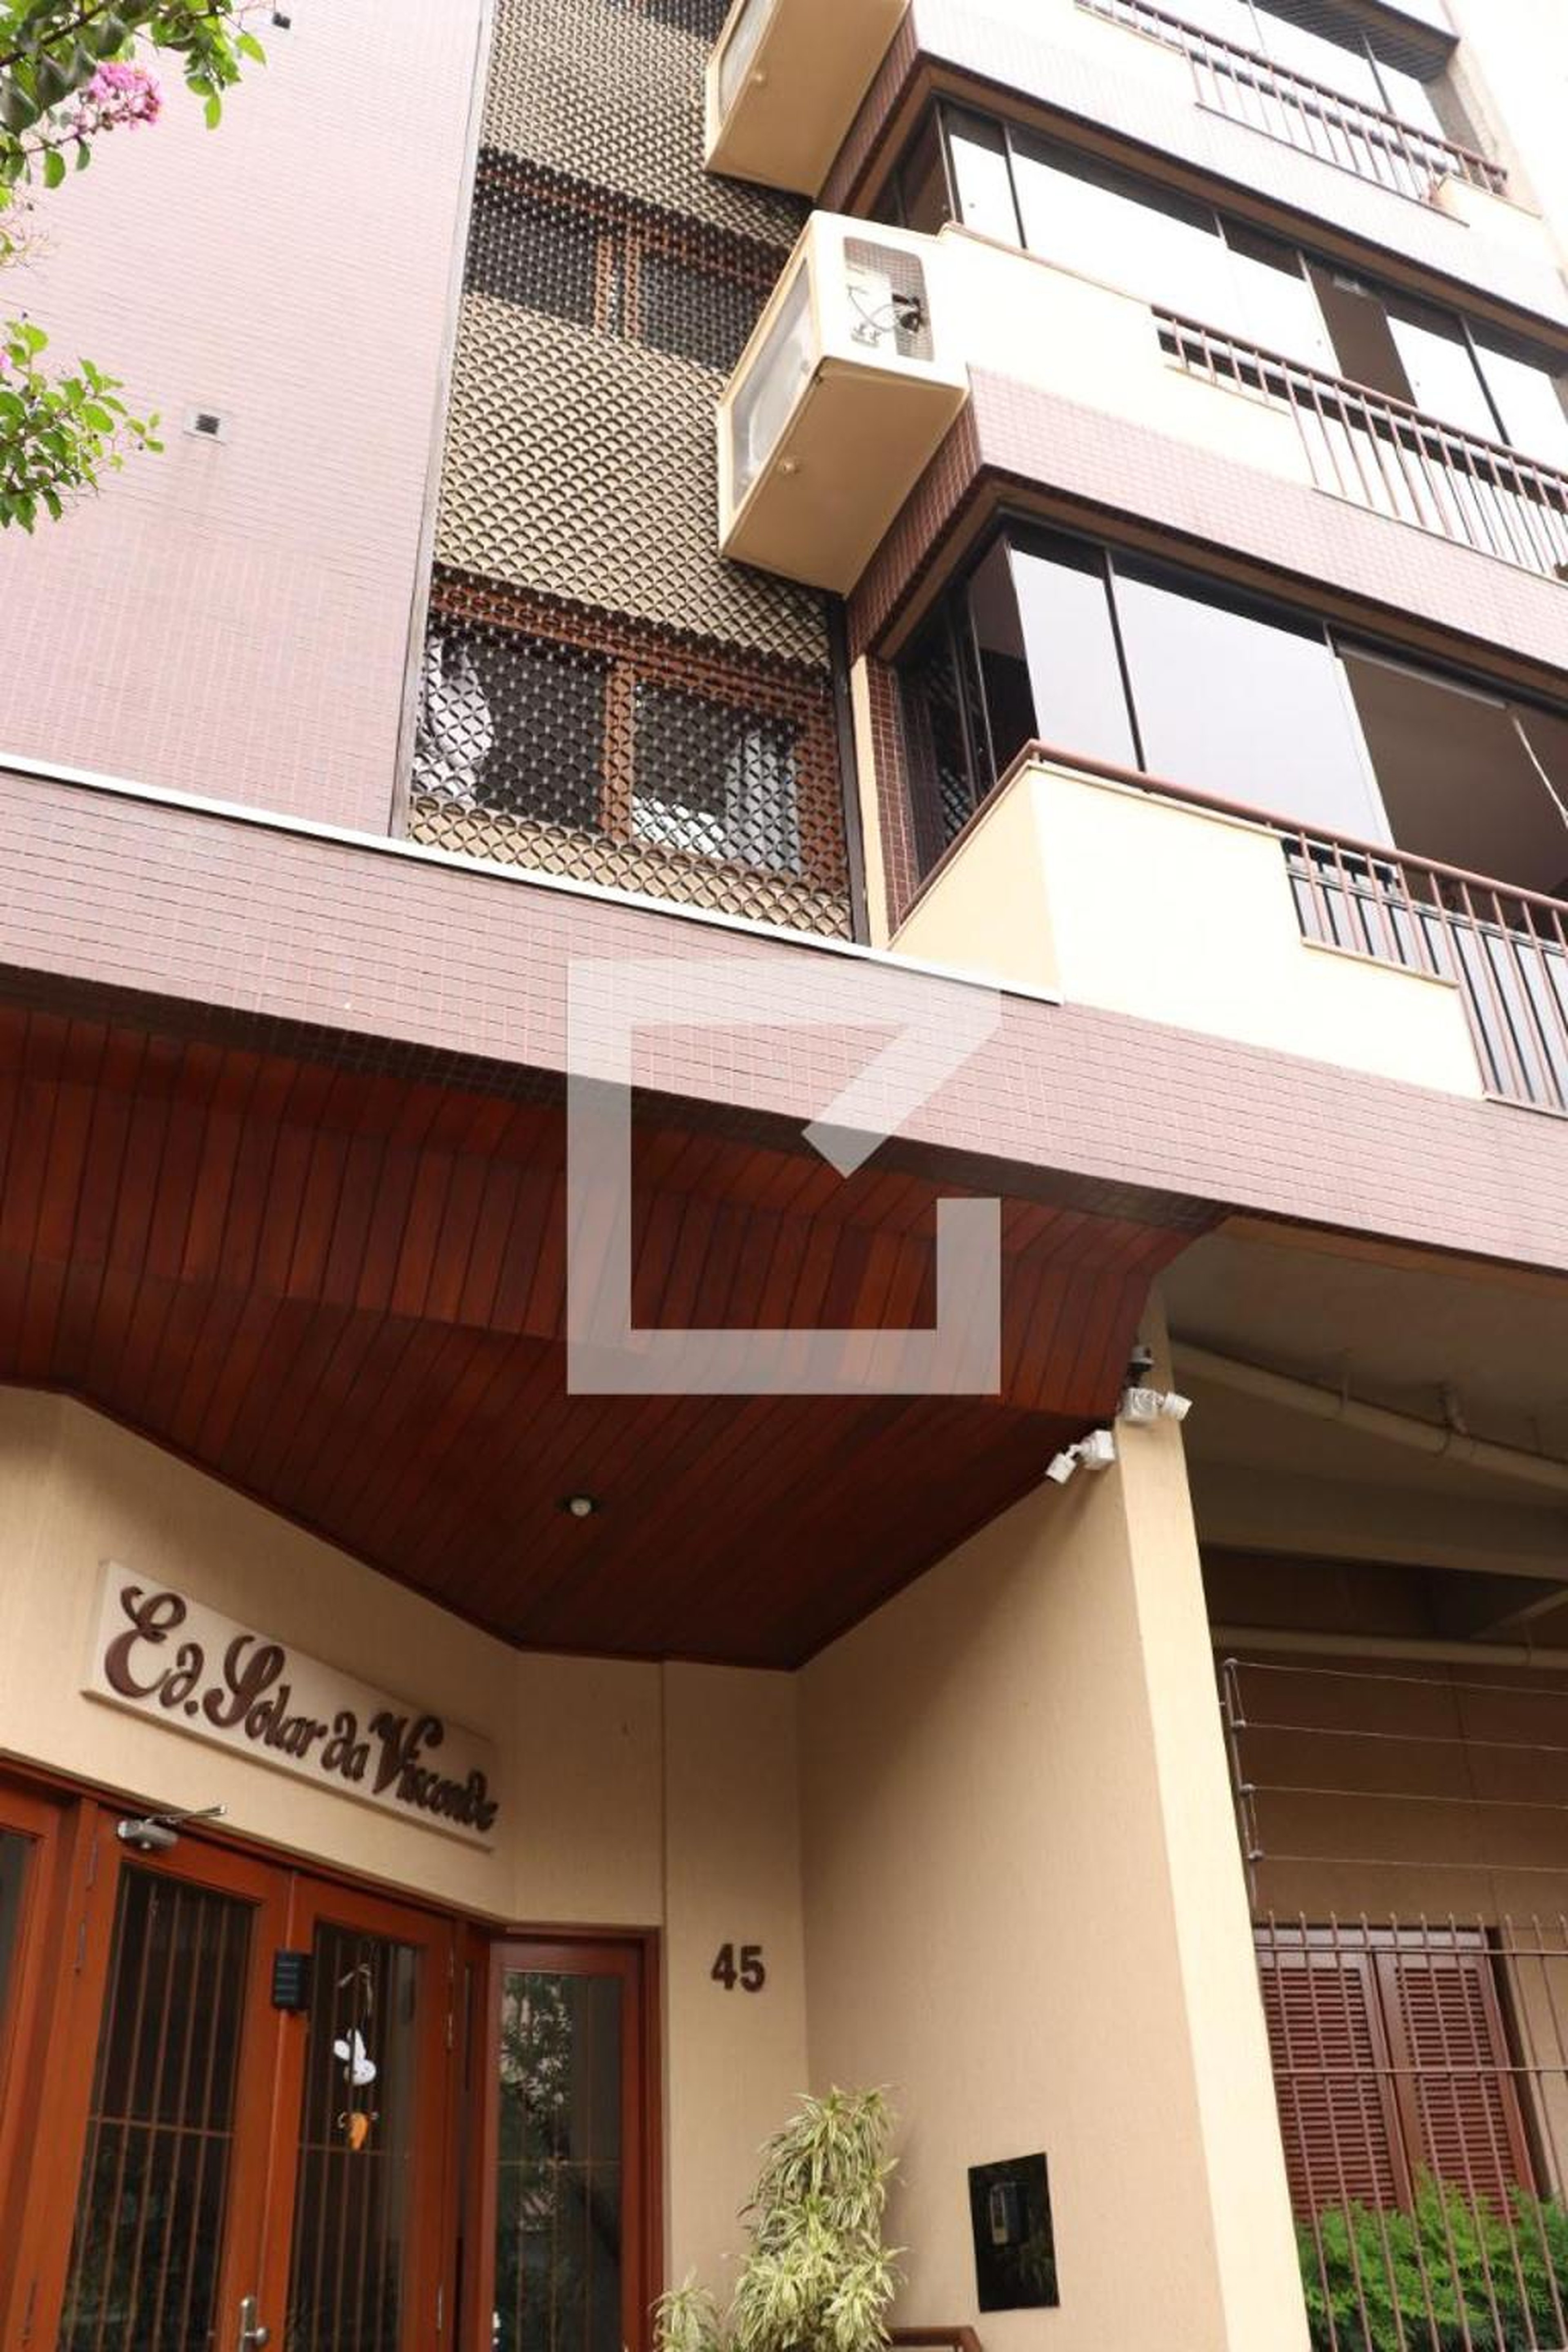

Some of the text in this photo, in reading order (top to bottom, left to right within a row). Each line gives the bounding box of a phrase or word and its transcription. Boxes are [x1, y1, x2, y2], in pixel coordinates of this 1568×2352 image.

[105, 1586, 499, 1832] Ed. Solar da Visconde
[710, 1942, 765, 1993] 45
